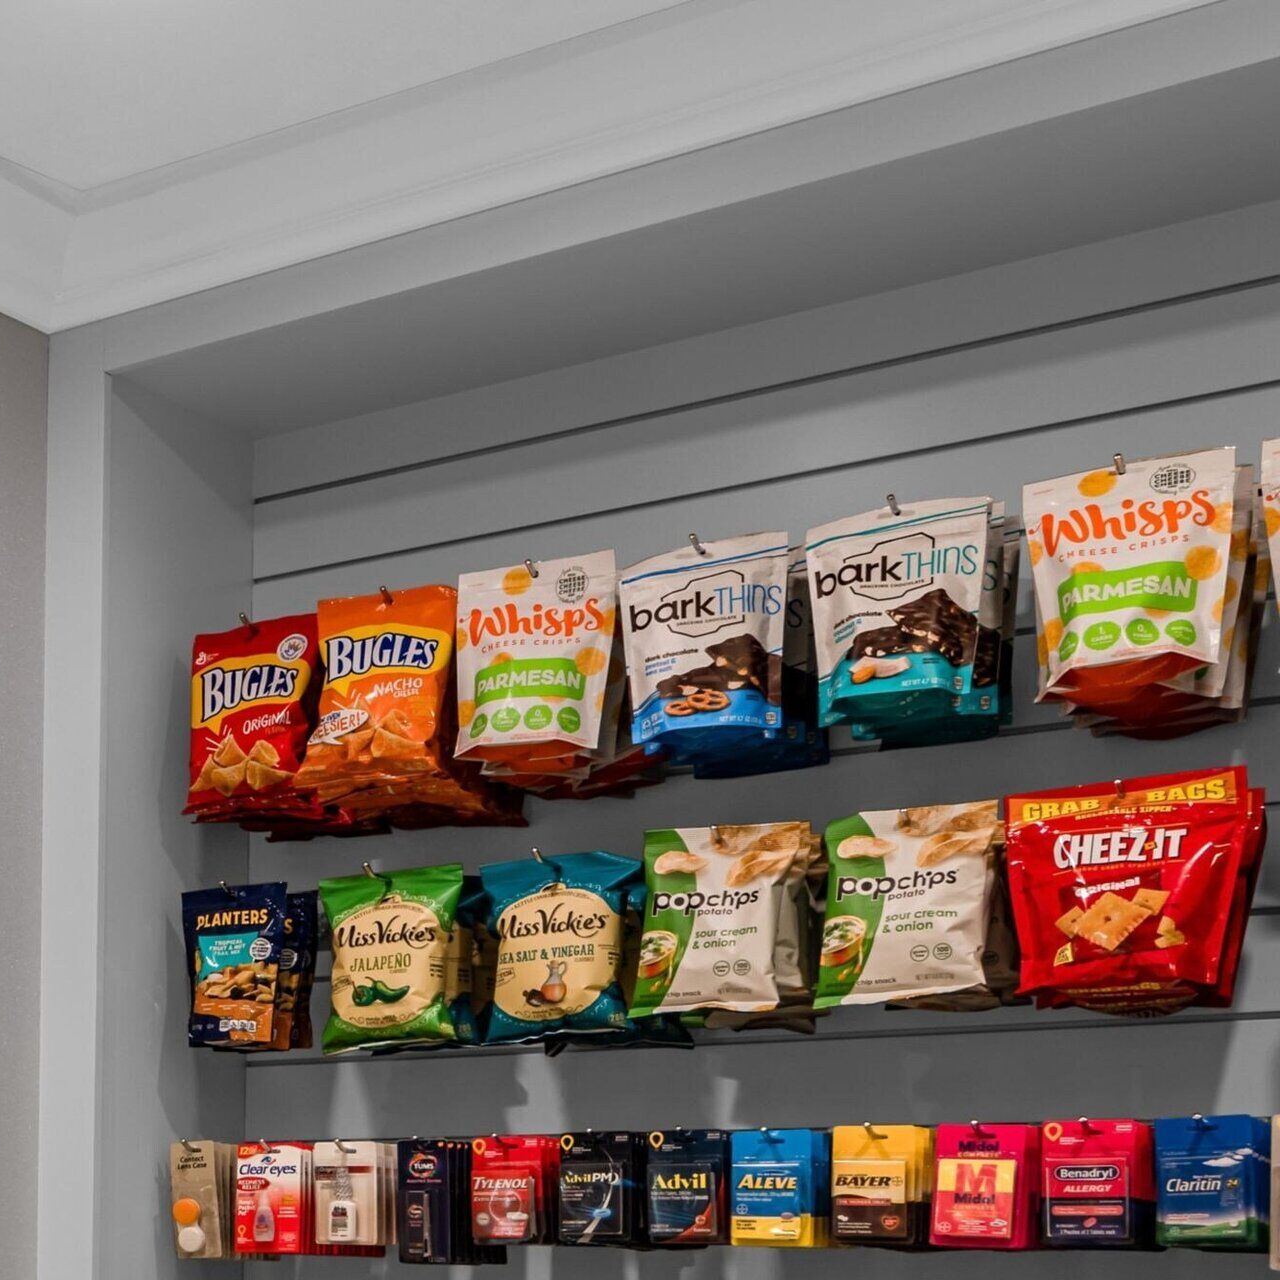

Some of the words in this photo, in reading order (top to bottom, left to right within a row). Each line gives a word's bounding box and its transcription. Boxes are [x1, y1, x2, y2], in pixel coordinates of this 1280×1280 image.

[1029, 489, 1216, 558] Whisps
[1058, 546, 1119, 563] CHEESE
[1129, 534, 1190, 551] CRISPS
[1062, 575, 1192, 613] PARMESAN
[460, 599, 608, 648] Whisps
[481, 638, 527, 654] CHEESE
[533, 636, 581, 646] CRISPS
[327, 633, 438, 683] BUGLES
[373, 677, 424, 698] NACHO
[478, 669, 581, 695] PARMESAN
[202, 664, 298, 723] BUGLES
[1022, 799, 1100, 822] GRAB
[1146, 779, 1226, 803] BAGS
[836, 870, 957, 901] popchips
[652, 889, 759, 916] popchips
[196, 908, 268, 931] PLANTERS
[500, 915, 539, 940] Miss
[537, 903, 607, 938] Vickie's
[697, 908, 733, 917] potato
[339, 924, 376, 948] Miss
[374, 915, 436, 949] Vickie's
[695, 927, 718, 939] sour
[720, 925, 758, 937] cream
[350, 953, 412, 972] JALAPEÑO
[498, 952, 514, 965] SEA
[516, 950, 538, 963] SALT
[540, 948, 548, 960] &
[551, 944, 594, 958] VINEGAR
[958, 1140, 999, 1152] Midol
[178, 1162, 192, 1170] Lens
[193, 1161, 207, 1169] Case
[180, 1155, 204, 1164] Contact
[412, 1162, 435, 1170] TUMS
[239, 1163, 268, 1175] Clear
[270, 1164, 297, 1177] eyes
[1059, 1168, 1114, 1180] Benadryl
[473, 1177, 528, 1189] TYLENOL
[653, 1173, 706, 1191] Advil
[738, 1176, 797, 1189] ALEVE
[835, 1176, 890, 1188] BAYER
[1063, 1184, 1112, 1193] ALLERGY
[1166, 1178, 1221, 1193] Claritin
